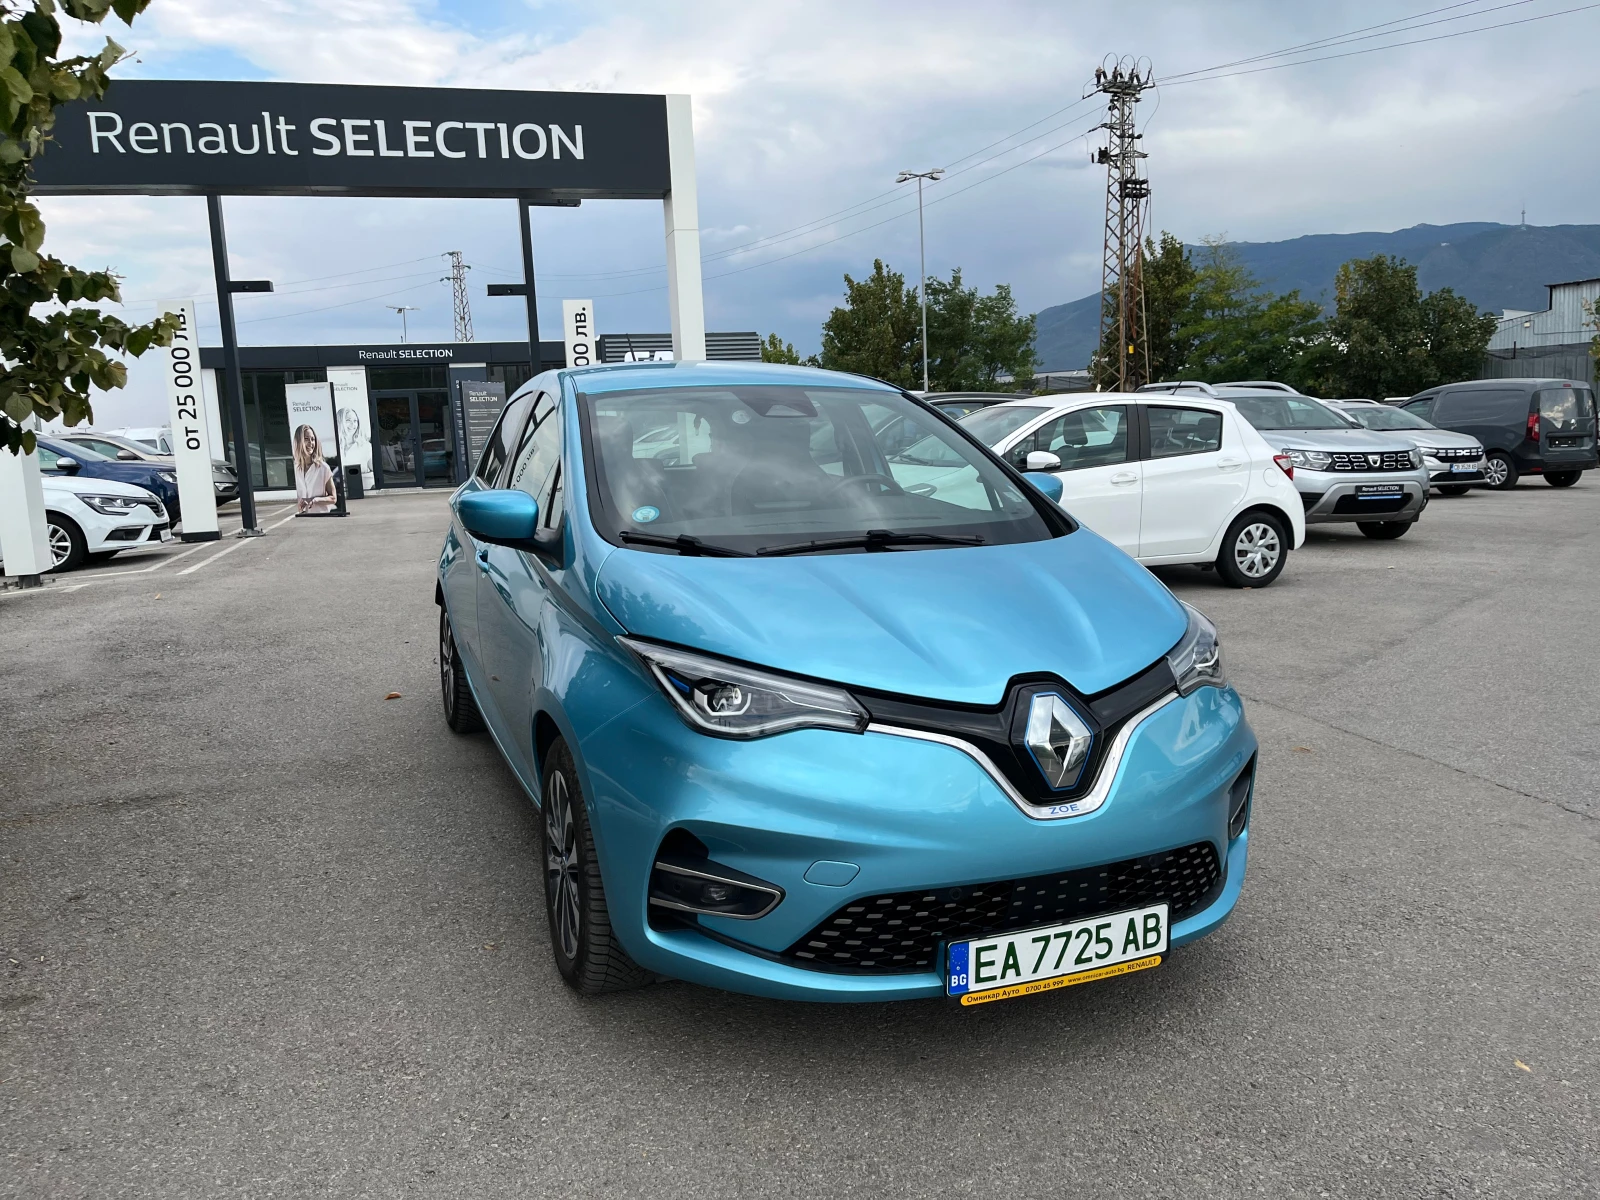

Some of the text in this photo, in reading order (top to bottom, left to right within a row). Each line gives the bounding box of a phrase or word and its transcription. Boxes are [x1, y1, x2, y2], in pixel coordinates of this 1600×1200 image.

[87, 111, 585, 160] Renault SELECTION
[575, 307, 588, 337] лв.
[171, 347, 193, 388] 000
[358, 349, 453, 359] Renault SELECTION
[177, 394, 197, 419] 25
[184, 426, 200, 450] от
[1049, 803, 1080, 815] ZOE
[974, 912, 1162, 984] EA 7725 AB
[951, 974, 967, 987] BG
[966, 992, 1000, 1003] Омникар
[1002, 989, 1020, 997] Ауто
[1025, 984, 1042, 993] 0700
[1127, 958, 1158, 971] RENAULT
